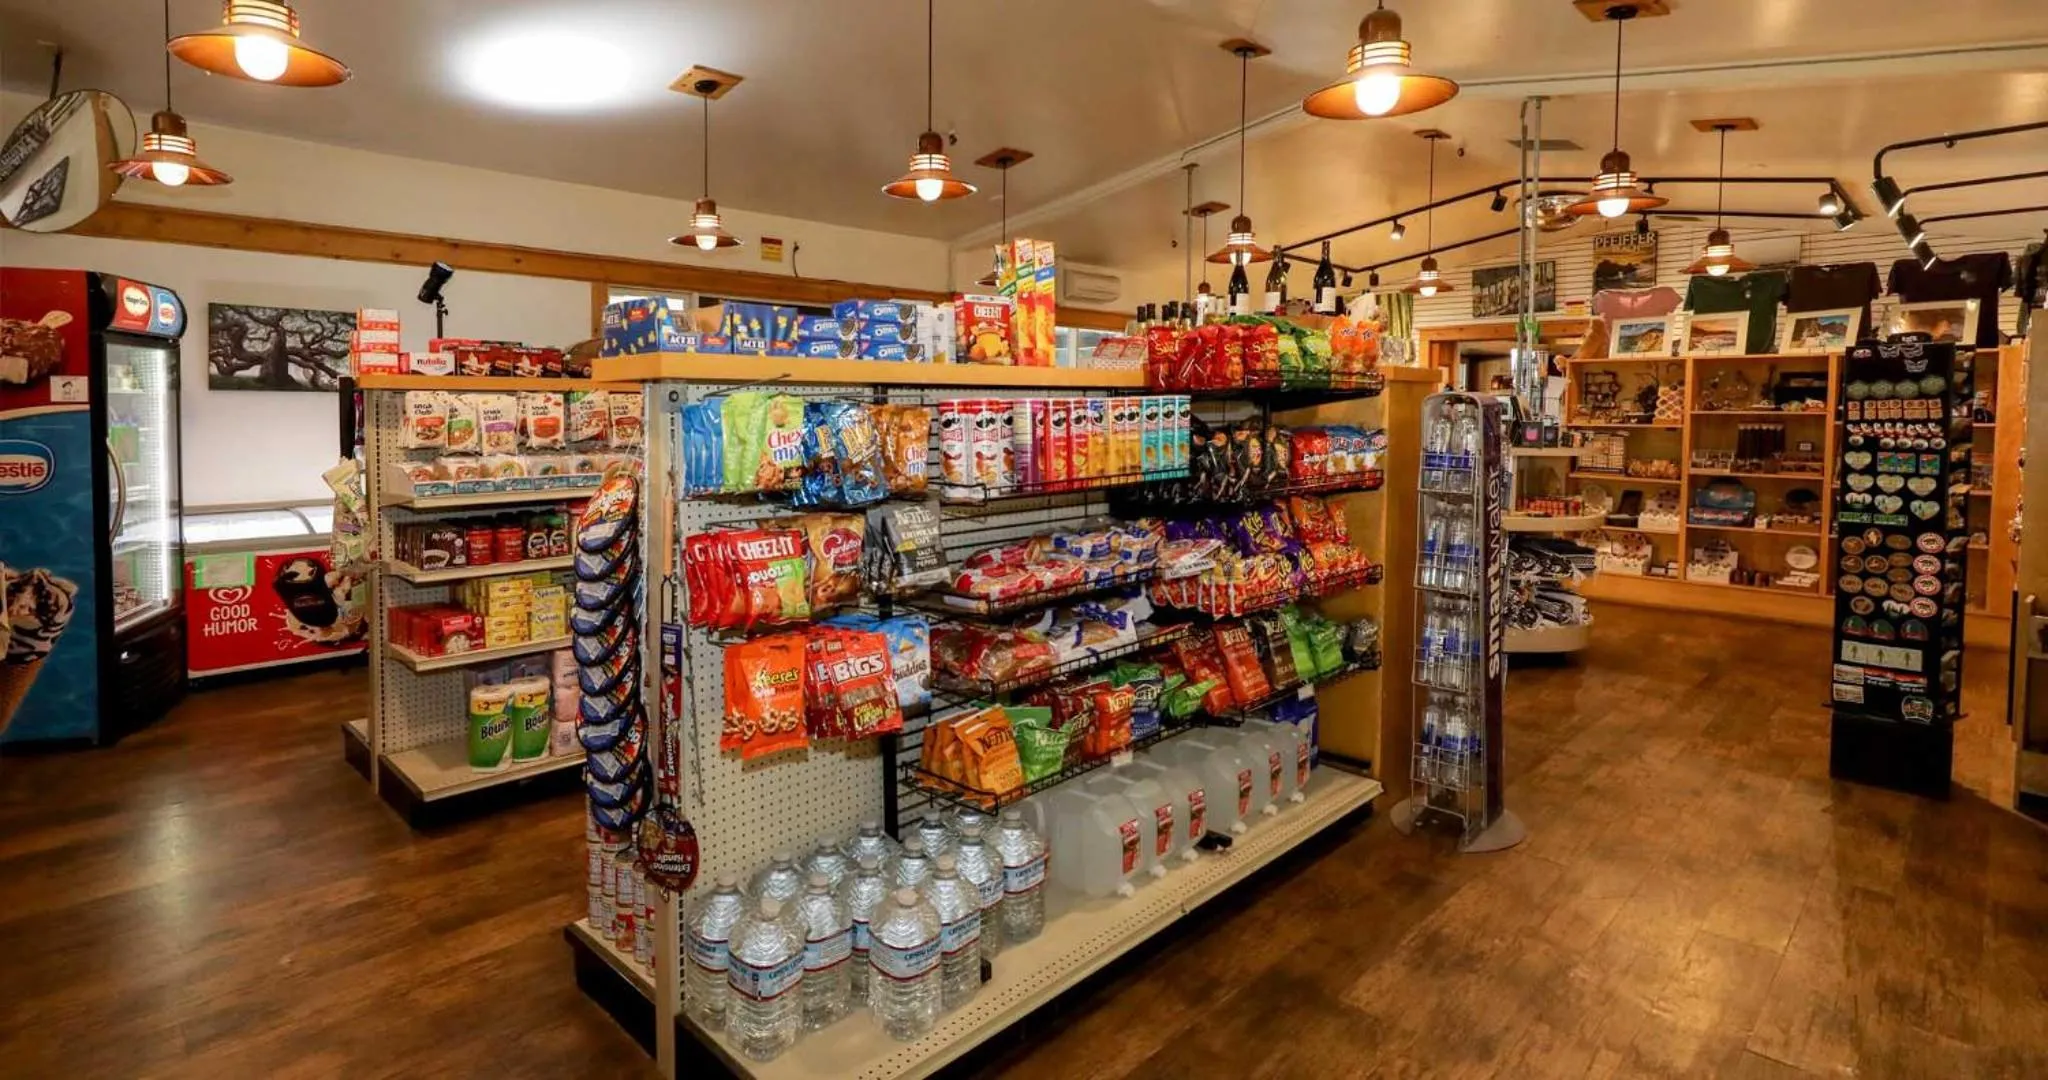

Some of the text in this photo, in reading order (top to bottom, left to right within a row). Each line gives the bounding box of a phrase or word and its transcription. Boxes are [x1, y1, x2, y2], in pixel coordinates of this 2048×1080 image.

[1594, 231, 1657, 248] PFEIFFER
[1489, 465, 1502, 681] smartwater
[210, 604, 250, 621] GOOD
[203, 617, 258, 637] HUMOR
[834, 652, 886, 684] BIGS
